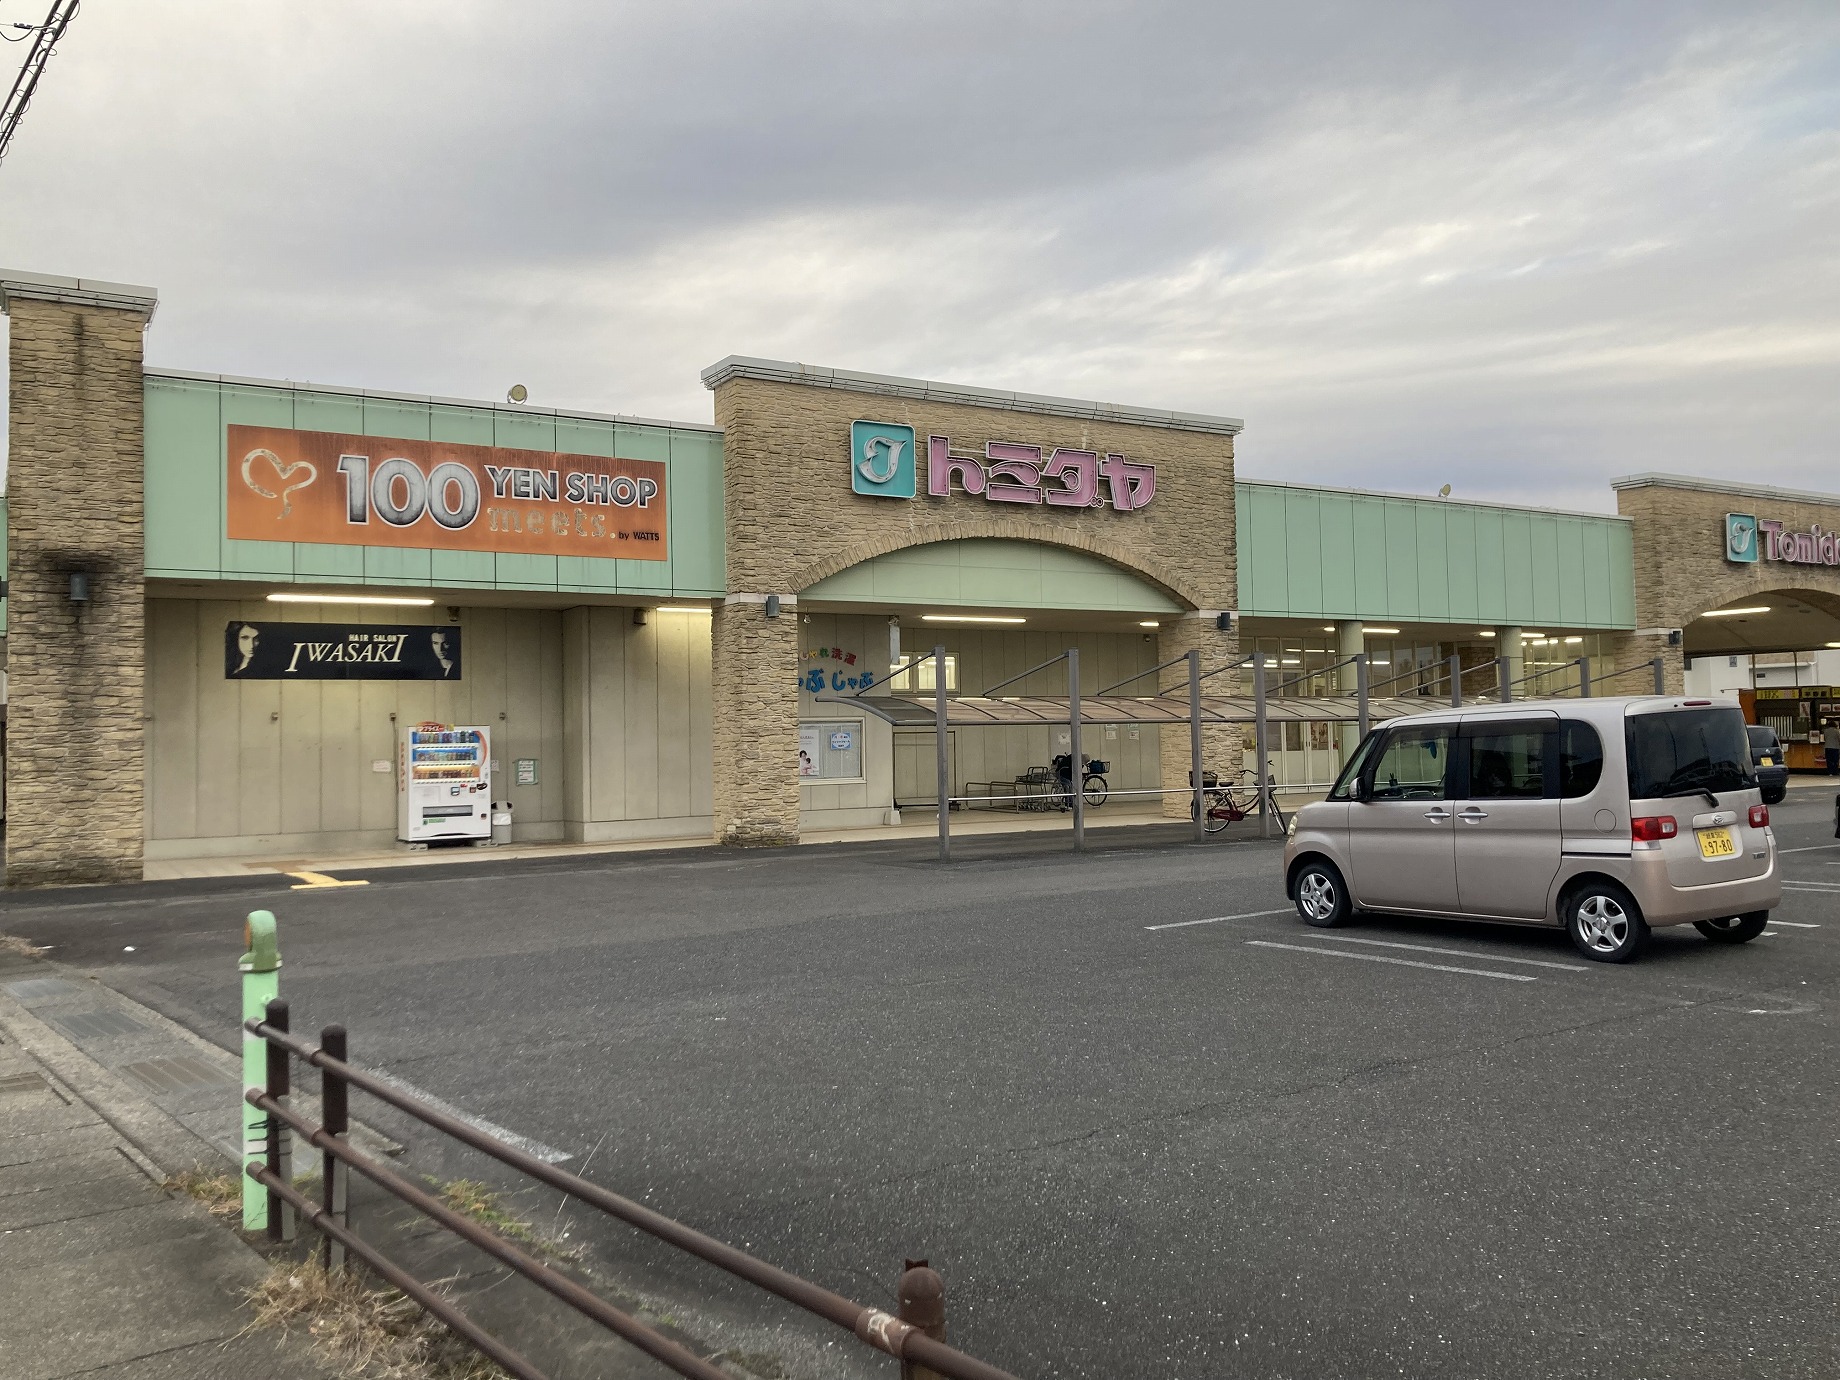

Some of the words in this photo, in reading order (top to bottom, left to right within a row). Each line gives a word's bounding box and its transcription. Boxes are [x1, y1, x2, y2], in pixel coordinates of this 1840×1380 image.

[336, 454, 481, 530] 100
[484, 464, 559, 502] YEN
[564, 471, 658, 509] SHOP
[618, 531, 630, 541] by
[633, 531, 660, 541] WATTS
[1760, 519, 1840, 566] Tomid
[285, 634, 409, 672] IWASAKI
[349, 633, 369, 642] HAIR
[373, 633, 397, 642] SALON
